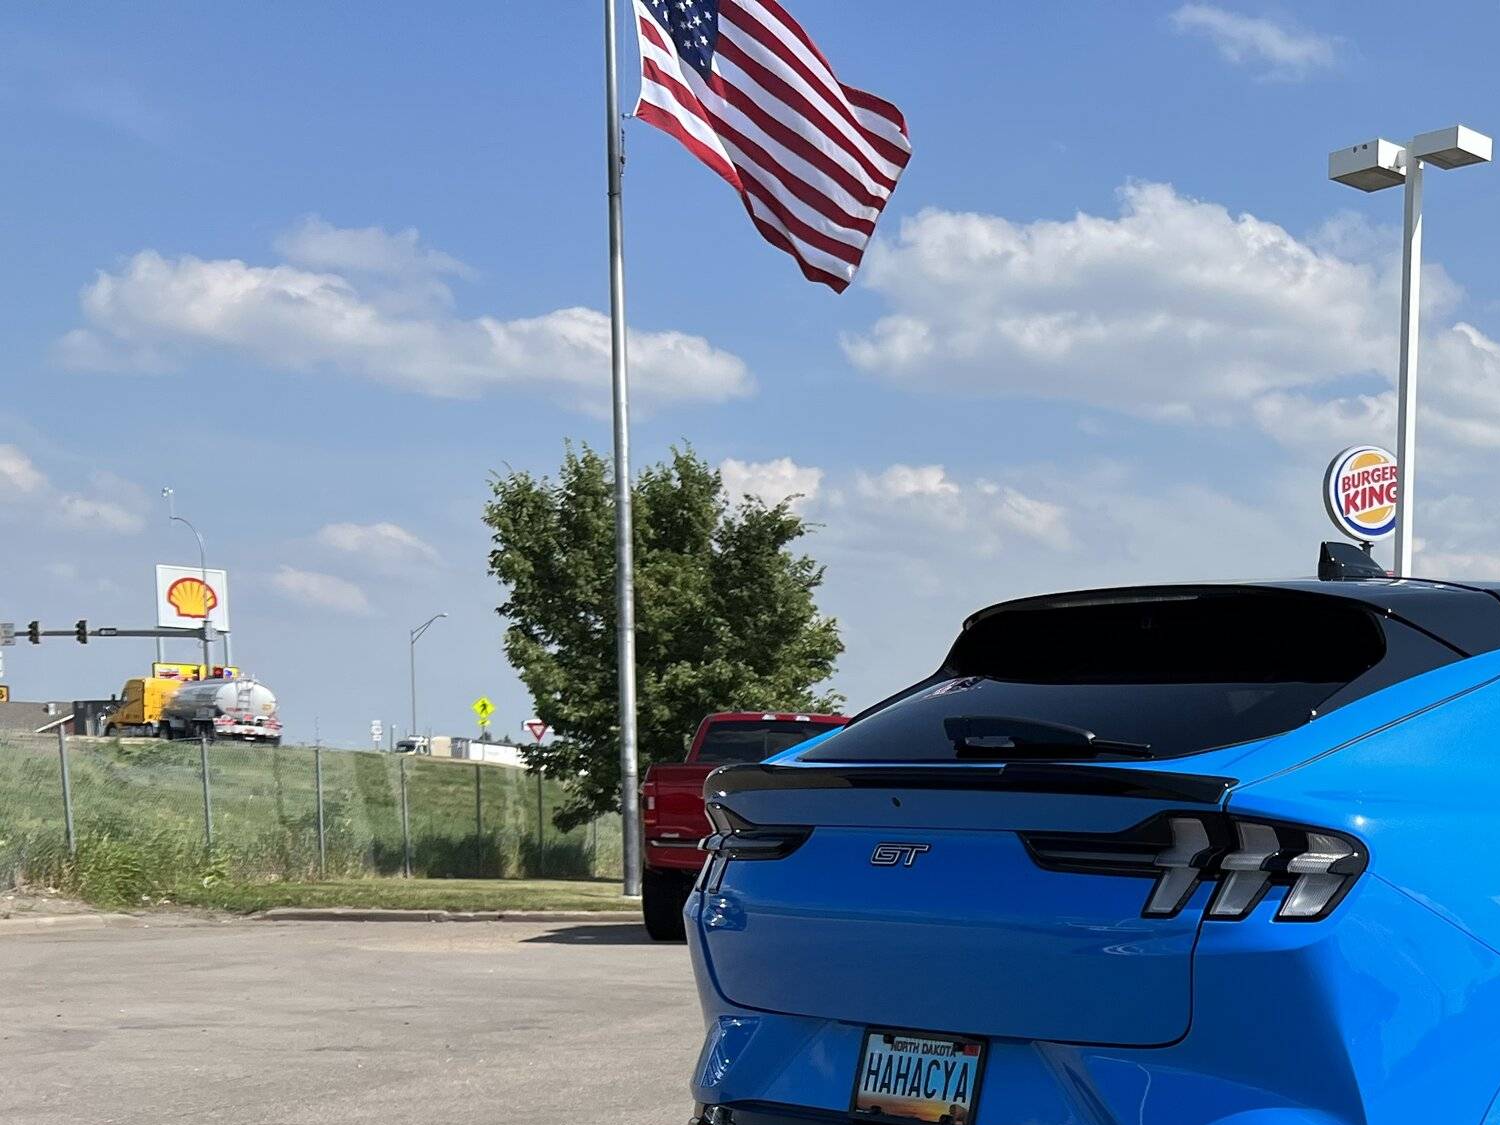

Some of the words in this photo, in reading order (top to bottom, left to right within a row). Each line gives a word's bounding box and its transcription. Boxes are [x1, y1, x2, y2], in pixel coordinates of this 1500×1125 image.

[1342, 466, 1398, 493] BURGER
[1344, 481, 1398, 515] KING
[870, 843, 929, 866] GT
[891, 1040, 919, 1053] NORTH
[922, 1043, 956, 1057] DAKOTA
[864, 1052, 969, 1103] HAHACYA
